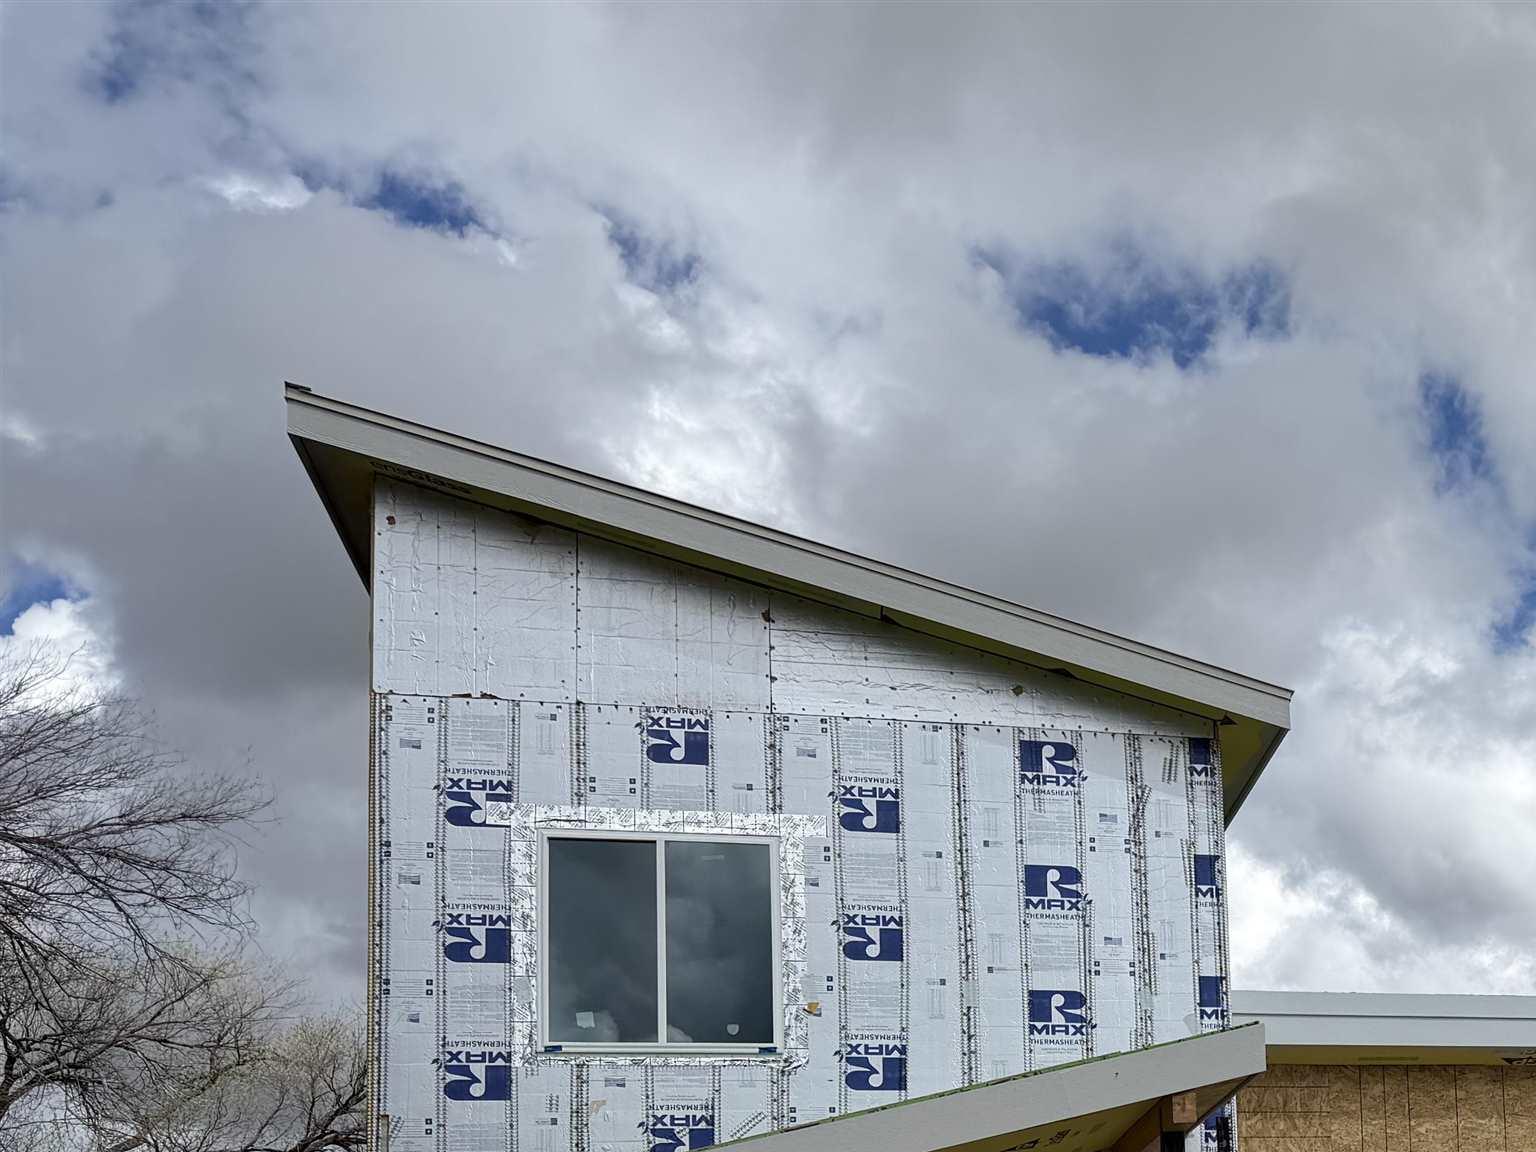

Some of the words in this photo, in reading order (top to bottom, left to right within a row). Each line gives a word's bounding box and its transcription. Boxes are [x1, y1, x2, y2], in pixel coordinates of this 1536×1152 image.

[647, 717, 709, 730] MAX
[445, 778, 511, 790] MAX
[1020, 774, 1077, 787] MAX
[840, 785, 899, 799] MAX
[1025, 899, 1082, 911] MAX
[446, 914, 511, 926] MAX
[843, 914, 903, 927] MAX
[1029, 1024, 1086, 1036] MAX
[846, 1044, 906, 1056] MAX
[445, 1051, 511, 1064] MAX
[651, 1114, 714, 1127] MAX
